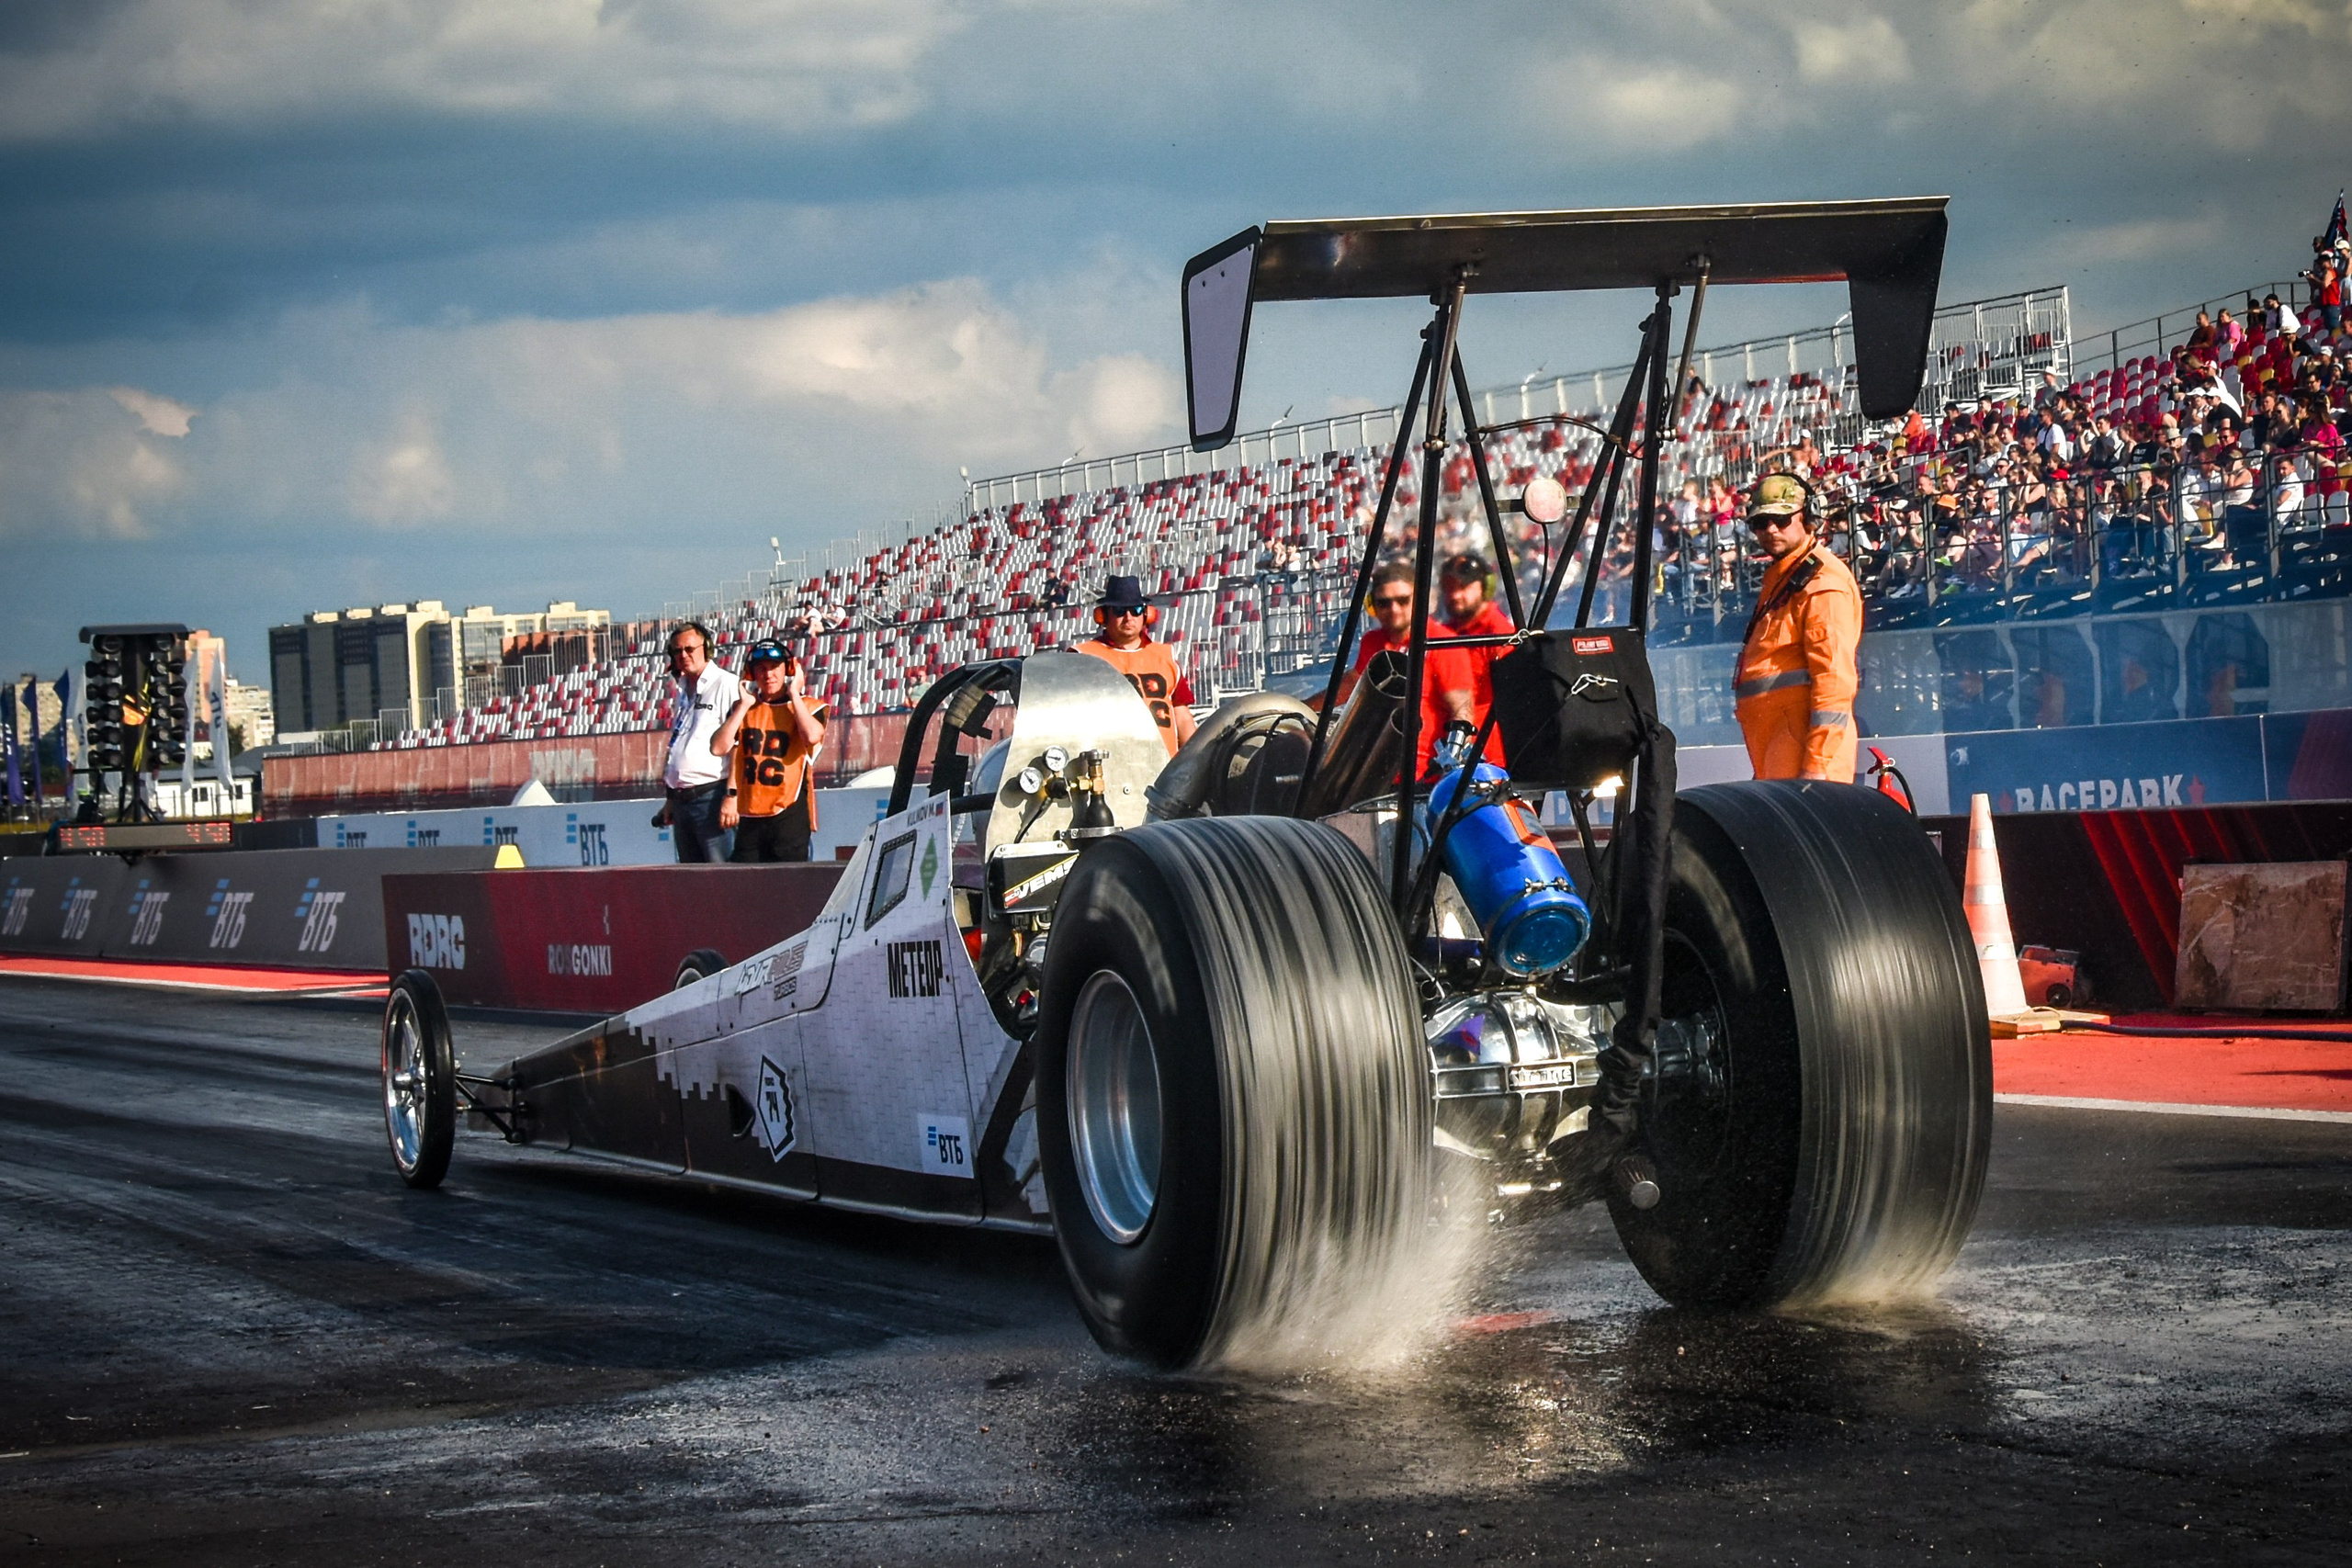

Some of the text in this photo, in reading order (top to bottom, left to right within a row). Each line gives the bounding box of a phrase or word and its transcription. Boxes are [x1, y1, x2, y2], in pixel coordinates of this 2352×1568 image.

[741, 727, 791, 758] RD
[2015, 774, 2184, 812] RACEPARK
[130, 891, 170, 945] ВТБ
[209, 891, 254, 948] ВТБ
[298, 891, 346, 952] ВТБ
[406, 912, 465, 970] RDRC
[548, 943, 613, 976] ROSGONKI
[937, 1133, 964, 1165] ВТБ
